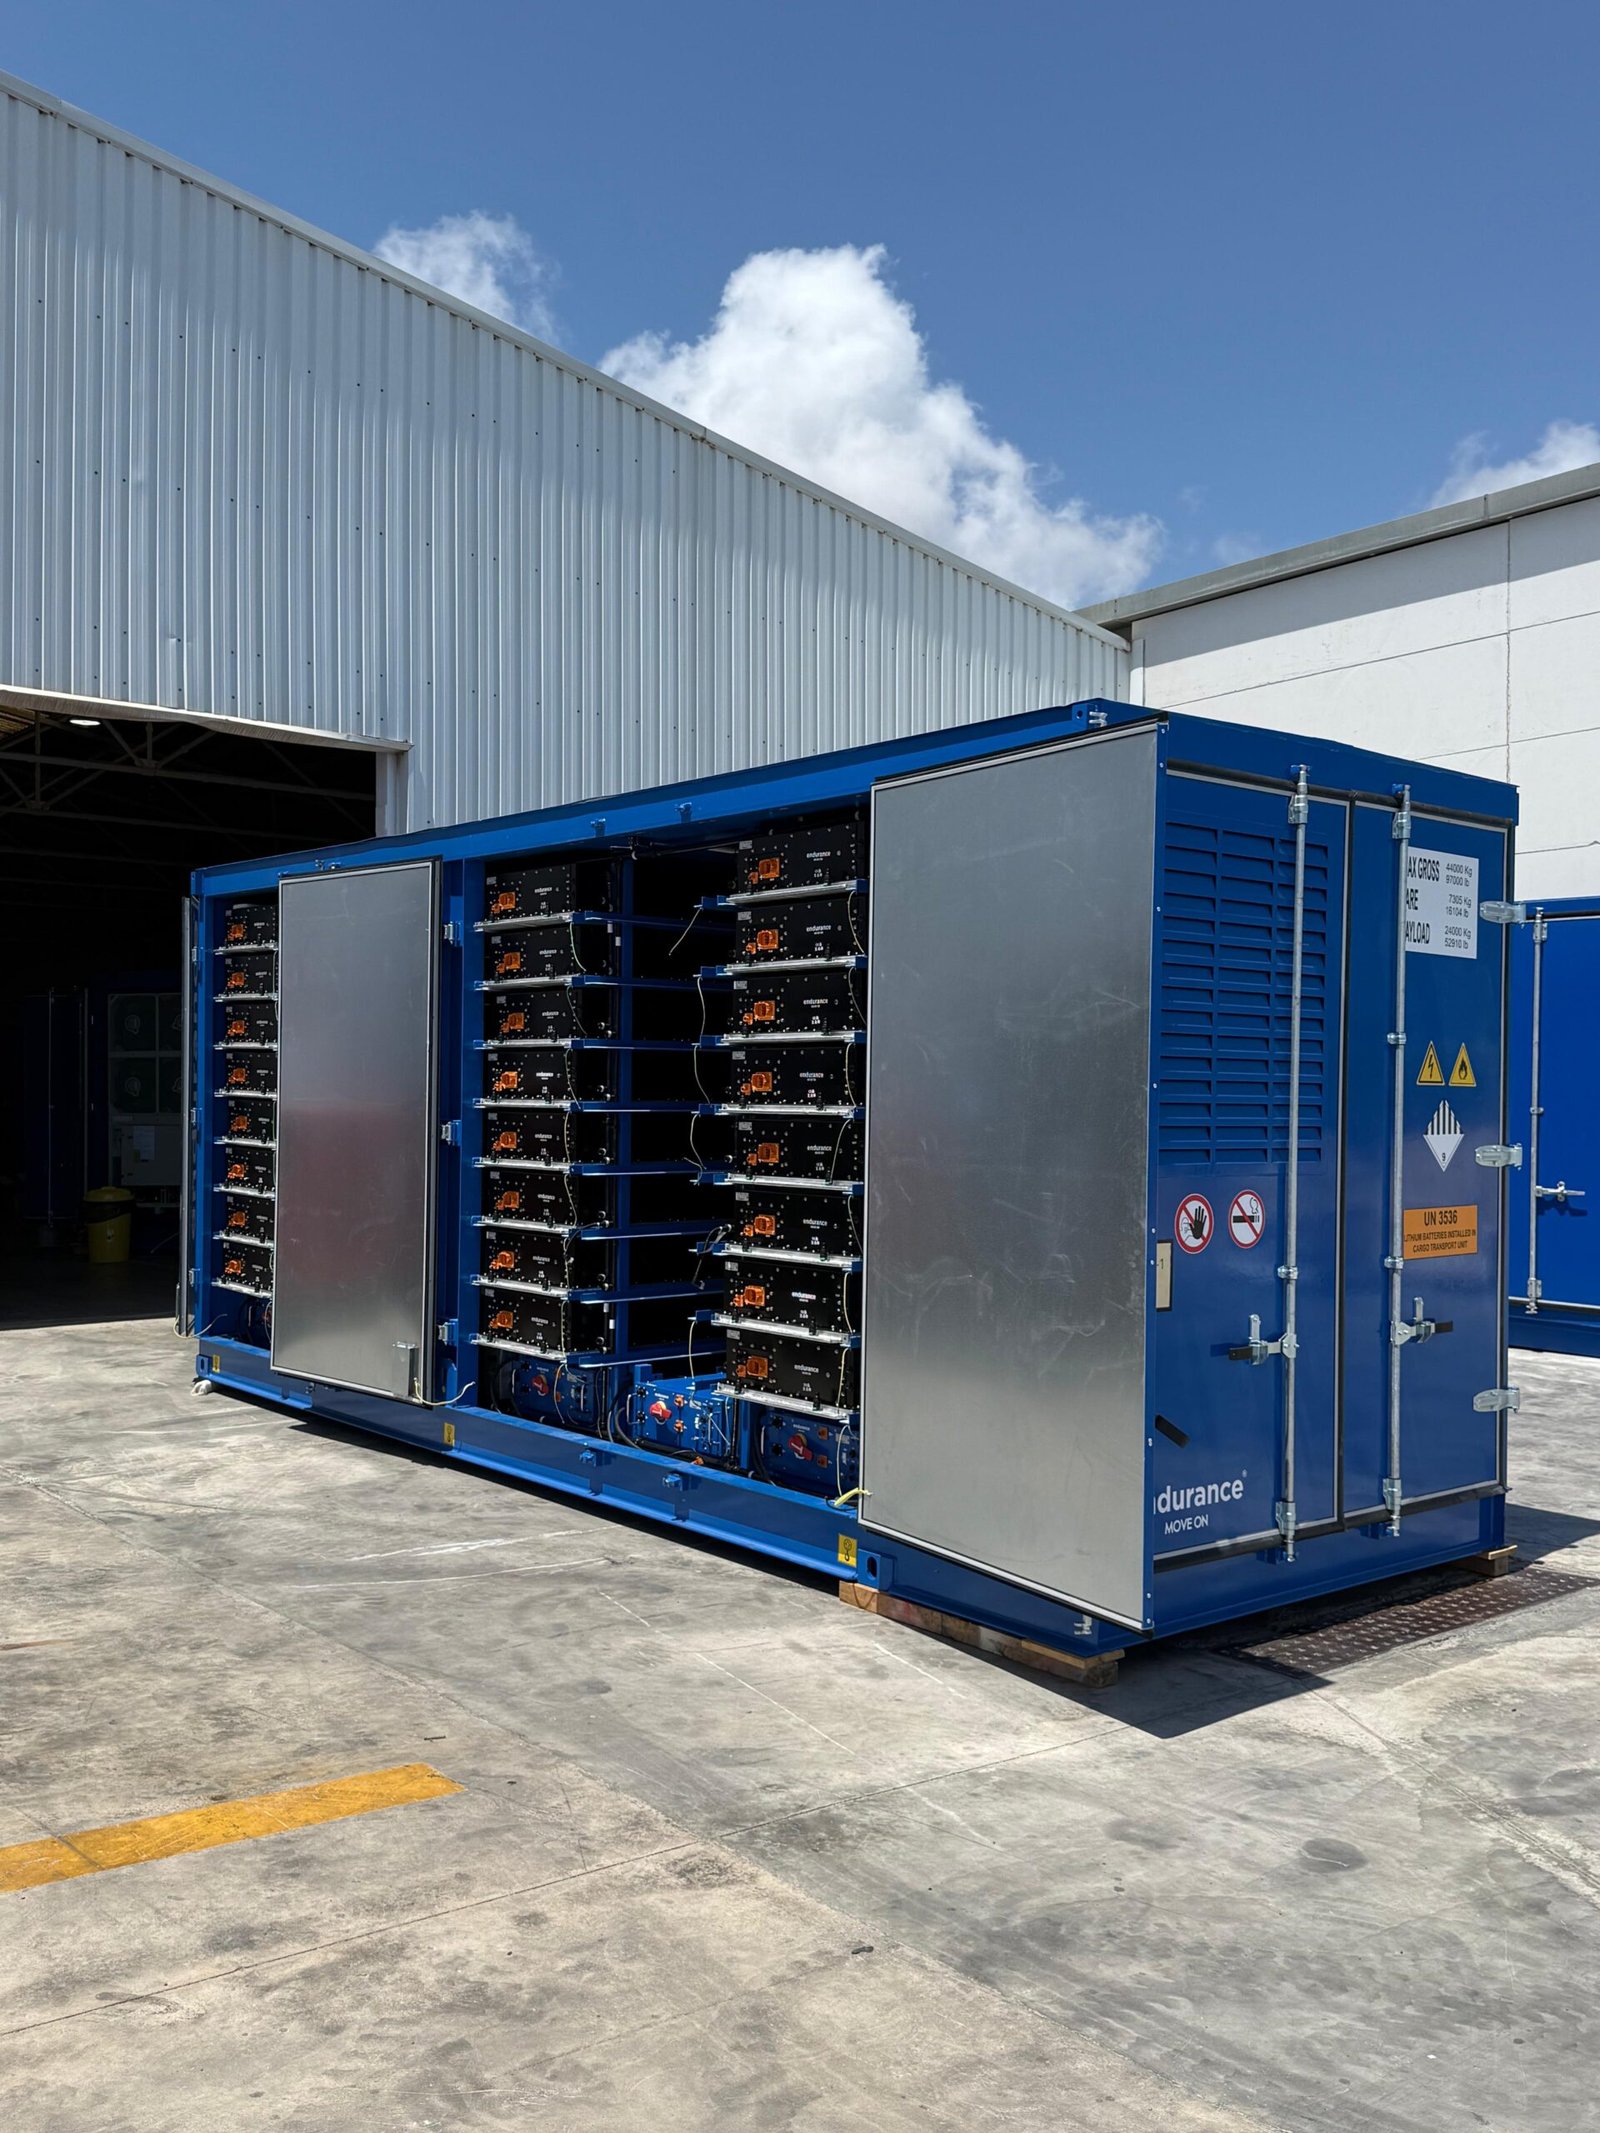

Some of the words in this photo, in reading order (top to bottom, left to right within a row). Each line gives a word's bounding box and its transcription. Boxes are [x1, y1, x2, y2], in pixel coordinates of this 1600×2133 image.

[1407, 856, 1417, 878] AX
[1418, 857, 1440, 882] GROSS
[1446, 863, 1463, 874] 44000
[1464, 865, 1472, 878] Kg
[1446, 874, 1463, 886] 97000
[1464, 877, 1470, 887] lb
[1406, 888, 1418, 910] ARE
[1449, 894, 1462, 905] 7305
[1463, 896, 1471, 908] Kg
[1463, 908, 1468, 918] lb
[1406, 921, 1430, 944] AYLOAD
[1444, 925, 1462, 937] 24000
[1463, 928, 1471, 940] Kg
[1444, 937, 1462, 949] 52910
[1463, 939, 1468, 949] lb
[1441, 1152, 1446, 1161] 9
[1424, 1211, 1437, 1226] UN
[1438, 1210, 1458, 1225] 3536
[1422, 1231, 1447, 1241] BATTERIES
[1447, 1229, 1471, 1238] INSTALLED
[1412, 1244, 1430, 1253] CARGO
[1430, 1241, 1457, 1251] TRANSPORT
[1457, 1240, 1468, 1249] UNIT
[1153, 1479, 1244, 1515] durance
[1164, 1517, 1193, 1535] MOVE
[1193, 1514, 1209, 1529] ON
